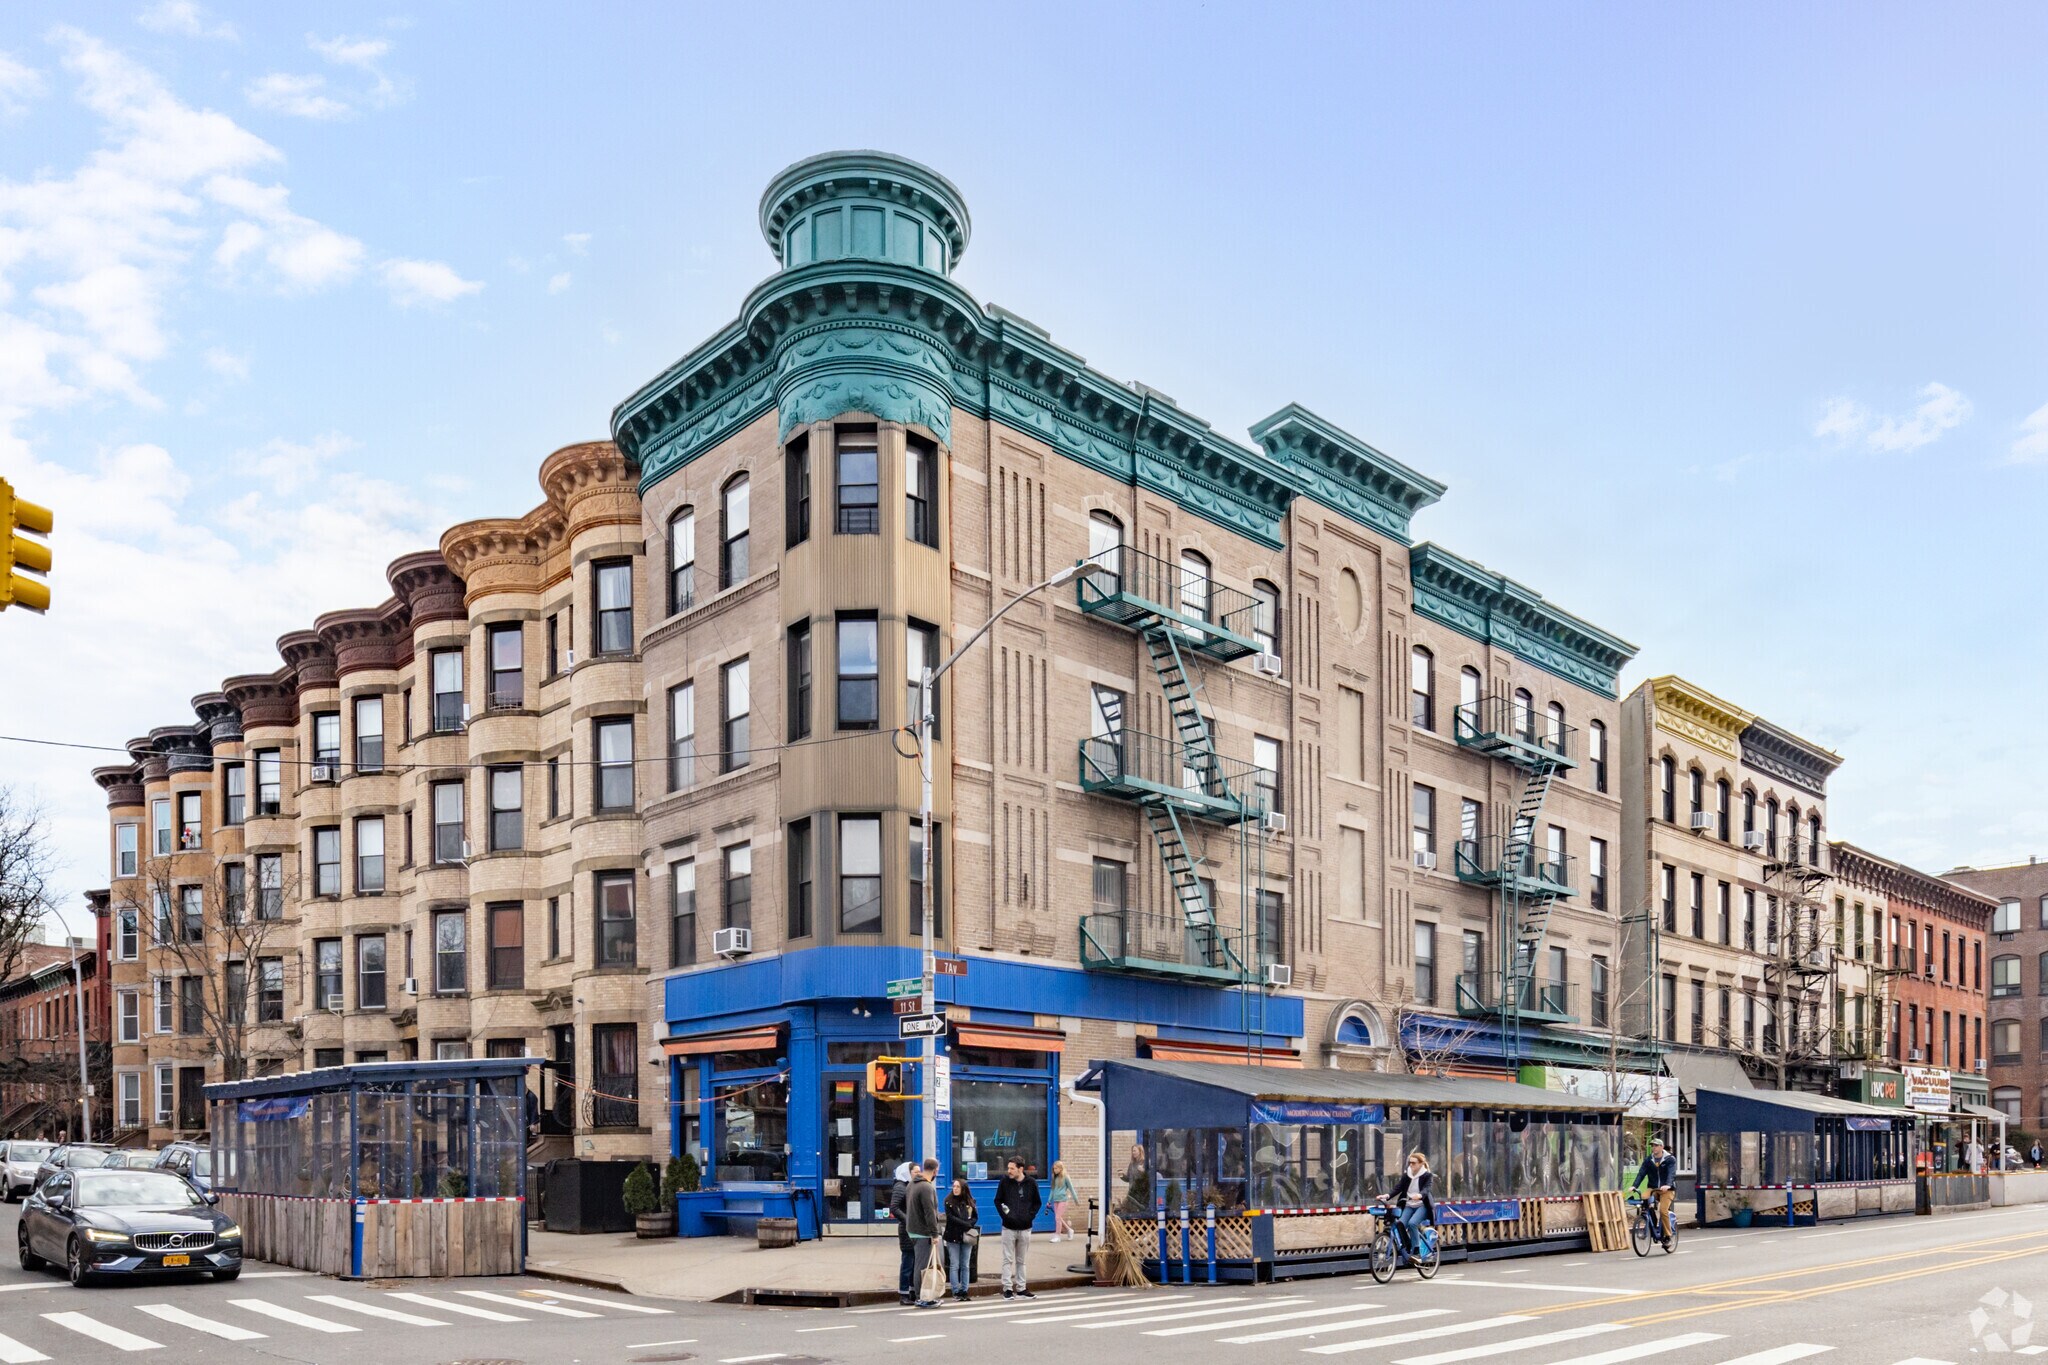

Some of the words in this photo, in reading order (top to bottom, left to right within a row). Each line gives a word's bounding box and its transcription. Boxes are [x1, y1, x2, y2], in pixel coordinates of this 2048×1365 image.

[900, 1001, 907, 1013] 11
[908, 1000, 916, 1012] St
[906, 1021, 920, 1032] ONE
[925, 1020, 940, 1030] WAY
[1911, 1073, 1950, 1088] VACUUMS
[965, 1133, 973, 1143] A
[983, 1128, 1017, 1147] Azul
